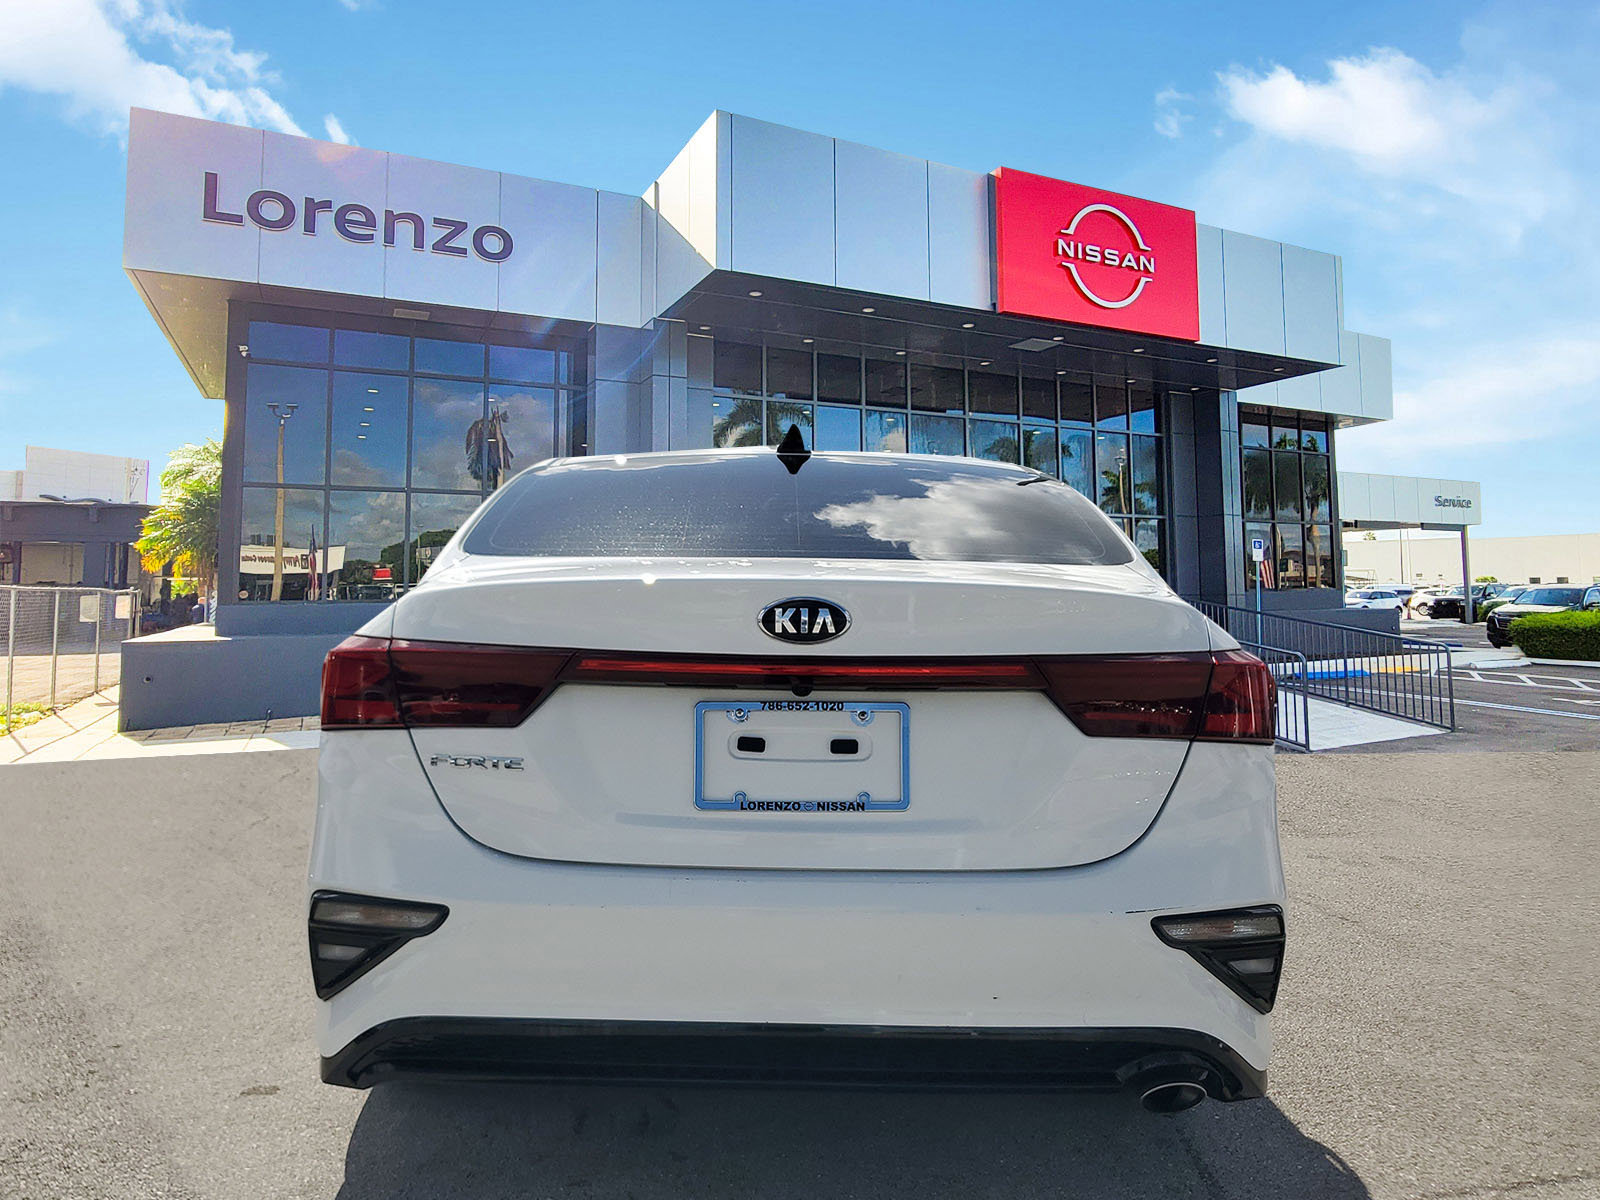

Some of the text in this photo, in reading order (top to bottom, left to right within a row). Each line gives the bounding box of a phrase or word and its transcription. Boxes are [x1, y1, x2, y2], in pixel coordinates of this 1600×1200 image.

[202, 171, 515, 262] Lorenzo
[1057, 238, 1155, 273] NISSAN
[1434, 495, 1472, 508] Service
[774, 607, 836, 633] KIA
[760, 701, 844, 712] 786-652-1020
[431, 753, 525, 771] FORTE
[740, 801, 865, 812] LORENZO NISSAN
